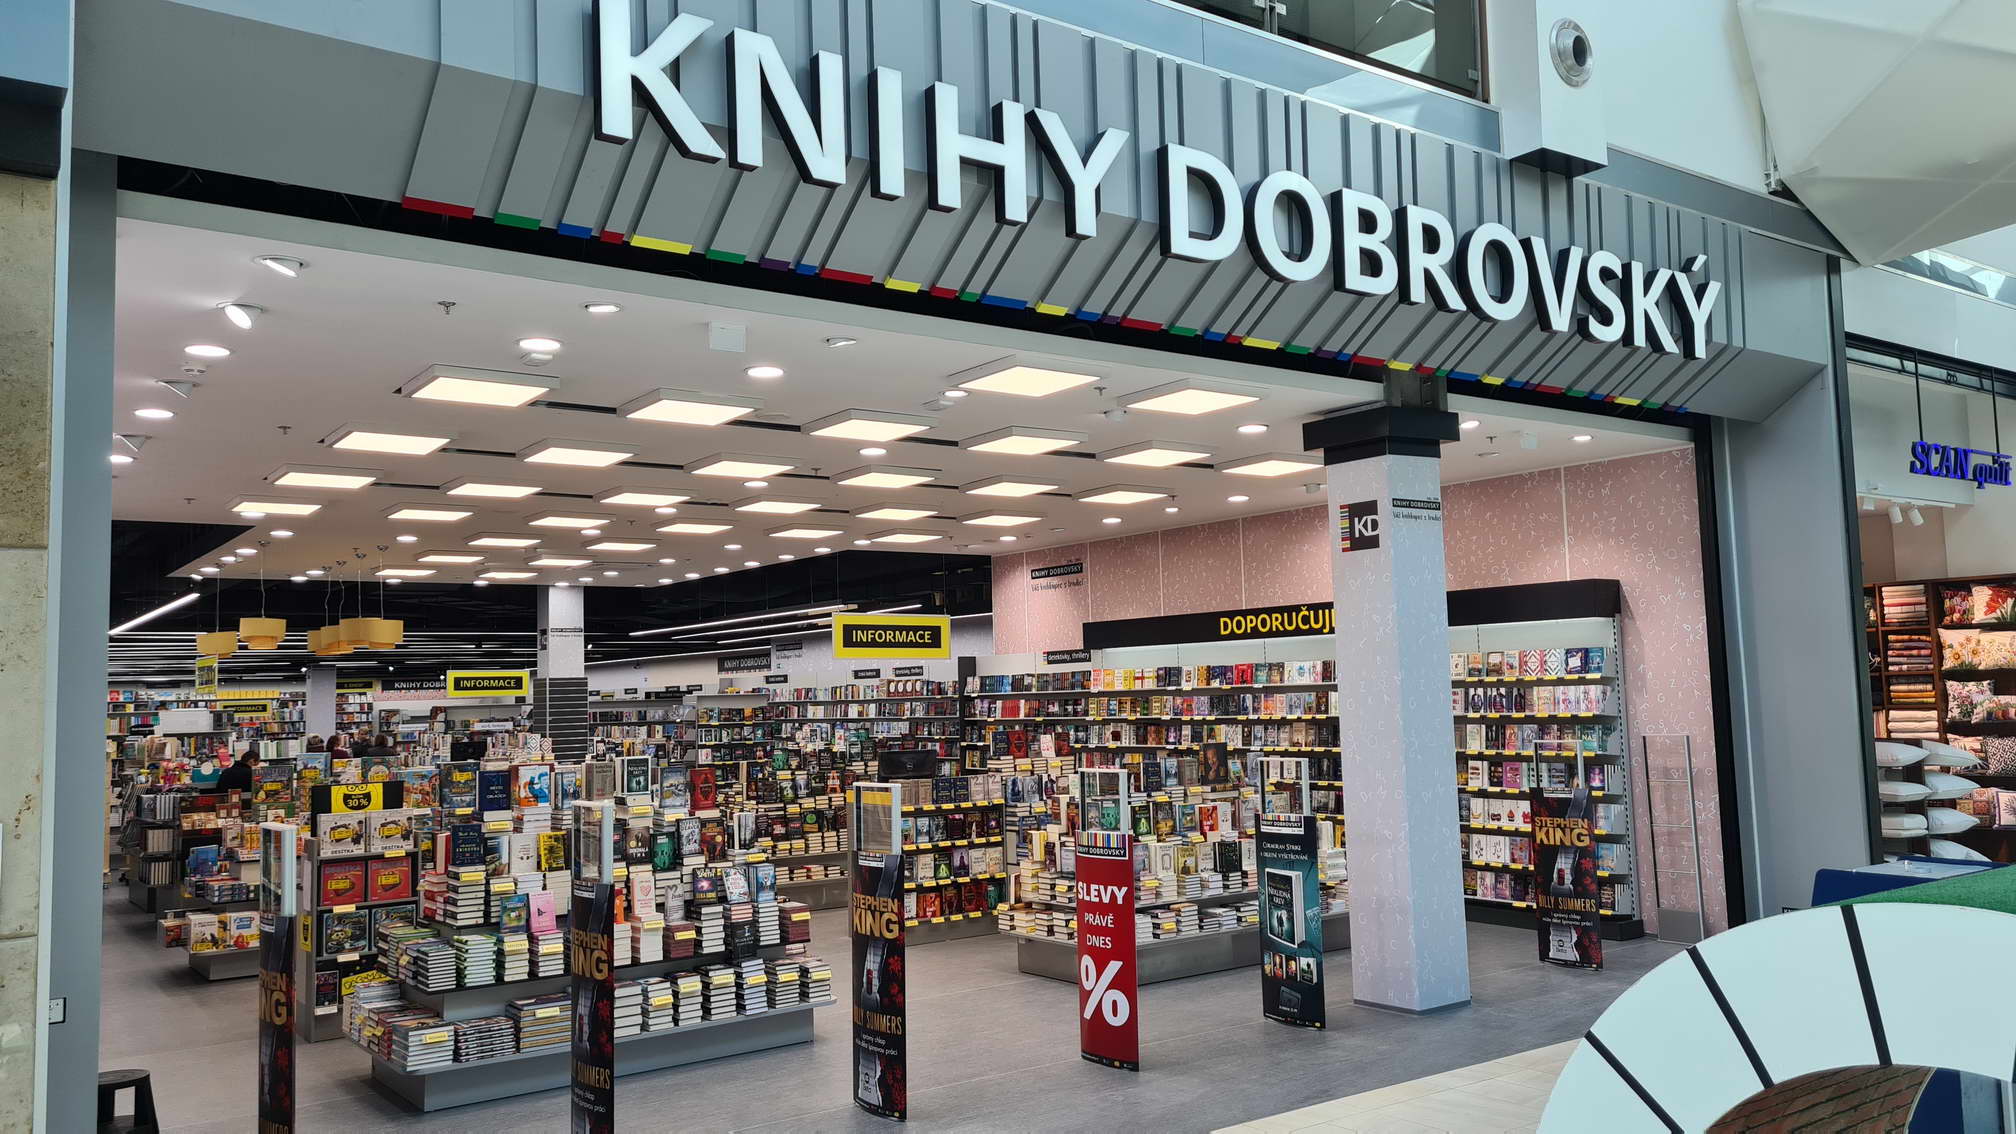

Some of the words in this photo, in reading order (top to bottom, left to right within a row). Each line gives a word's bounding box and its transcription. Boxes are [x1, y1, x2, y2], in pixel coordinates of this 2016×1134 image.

[594, 0, 1130, 240] KNIHY
[1158, 143, 1721, 359] DOBROVSKÝ
[1910, 441, 1969, 480] SCAN
[1972, 459, 2012, 489] quilt
[1354, 514, 1379, 538] KD
[1032, 569, 1048, 578] KNIHY
[1049, 564, 1082, 576] DOBROVSKÝ
[852, 629, 932, 643] INFORMACE
[724, 659, 740, 668] KNIHY
[1072, 651, 1090, 661] thrillery
[394, 681, 421, 689] KNIHY
[459, 678, 516, 688] INFORMACE
[346, 799, 358, 807] 30
[360, 798, 369, 807] %
[1535, 816, 1588, 829] STEPHEN
[1535, 828, 1590, 847] KING
[1088, 847, 1126, 857] DOBROVSKÝ
[1077, 881, 1129, 905] SLEVY
[852, 893, 898, 913] STEPHEN
[1558, 896, 1597, 912] SUMMERS
[853, 907, 899, 940] KING
[1084, 910, 1115, 928] PRÁVĚ
[571, 927, 608, 950] TEPHEN
[1086, 933, 1112, 949] DNES
[1080, 954, 1130, 1027] %
[866, 1010, 902, 1035] SUMMERS
[577, 1061, 611, 1089] SUMMERS
